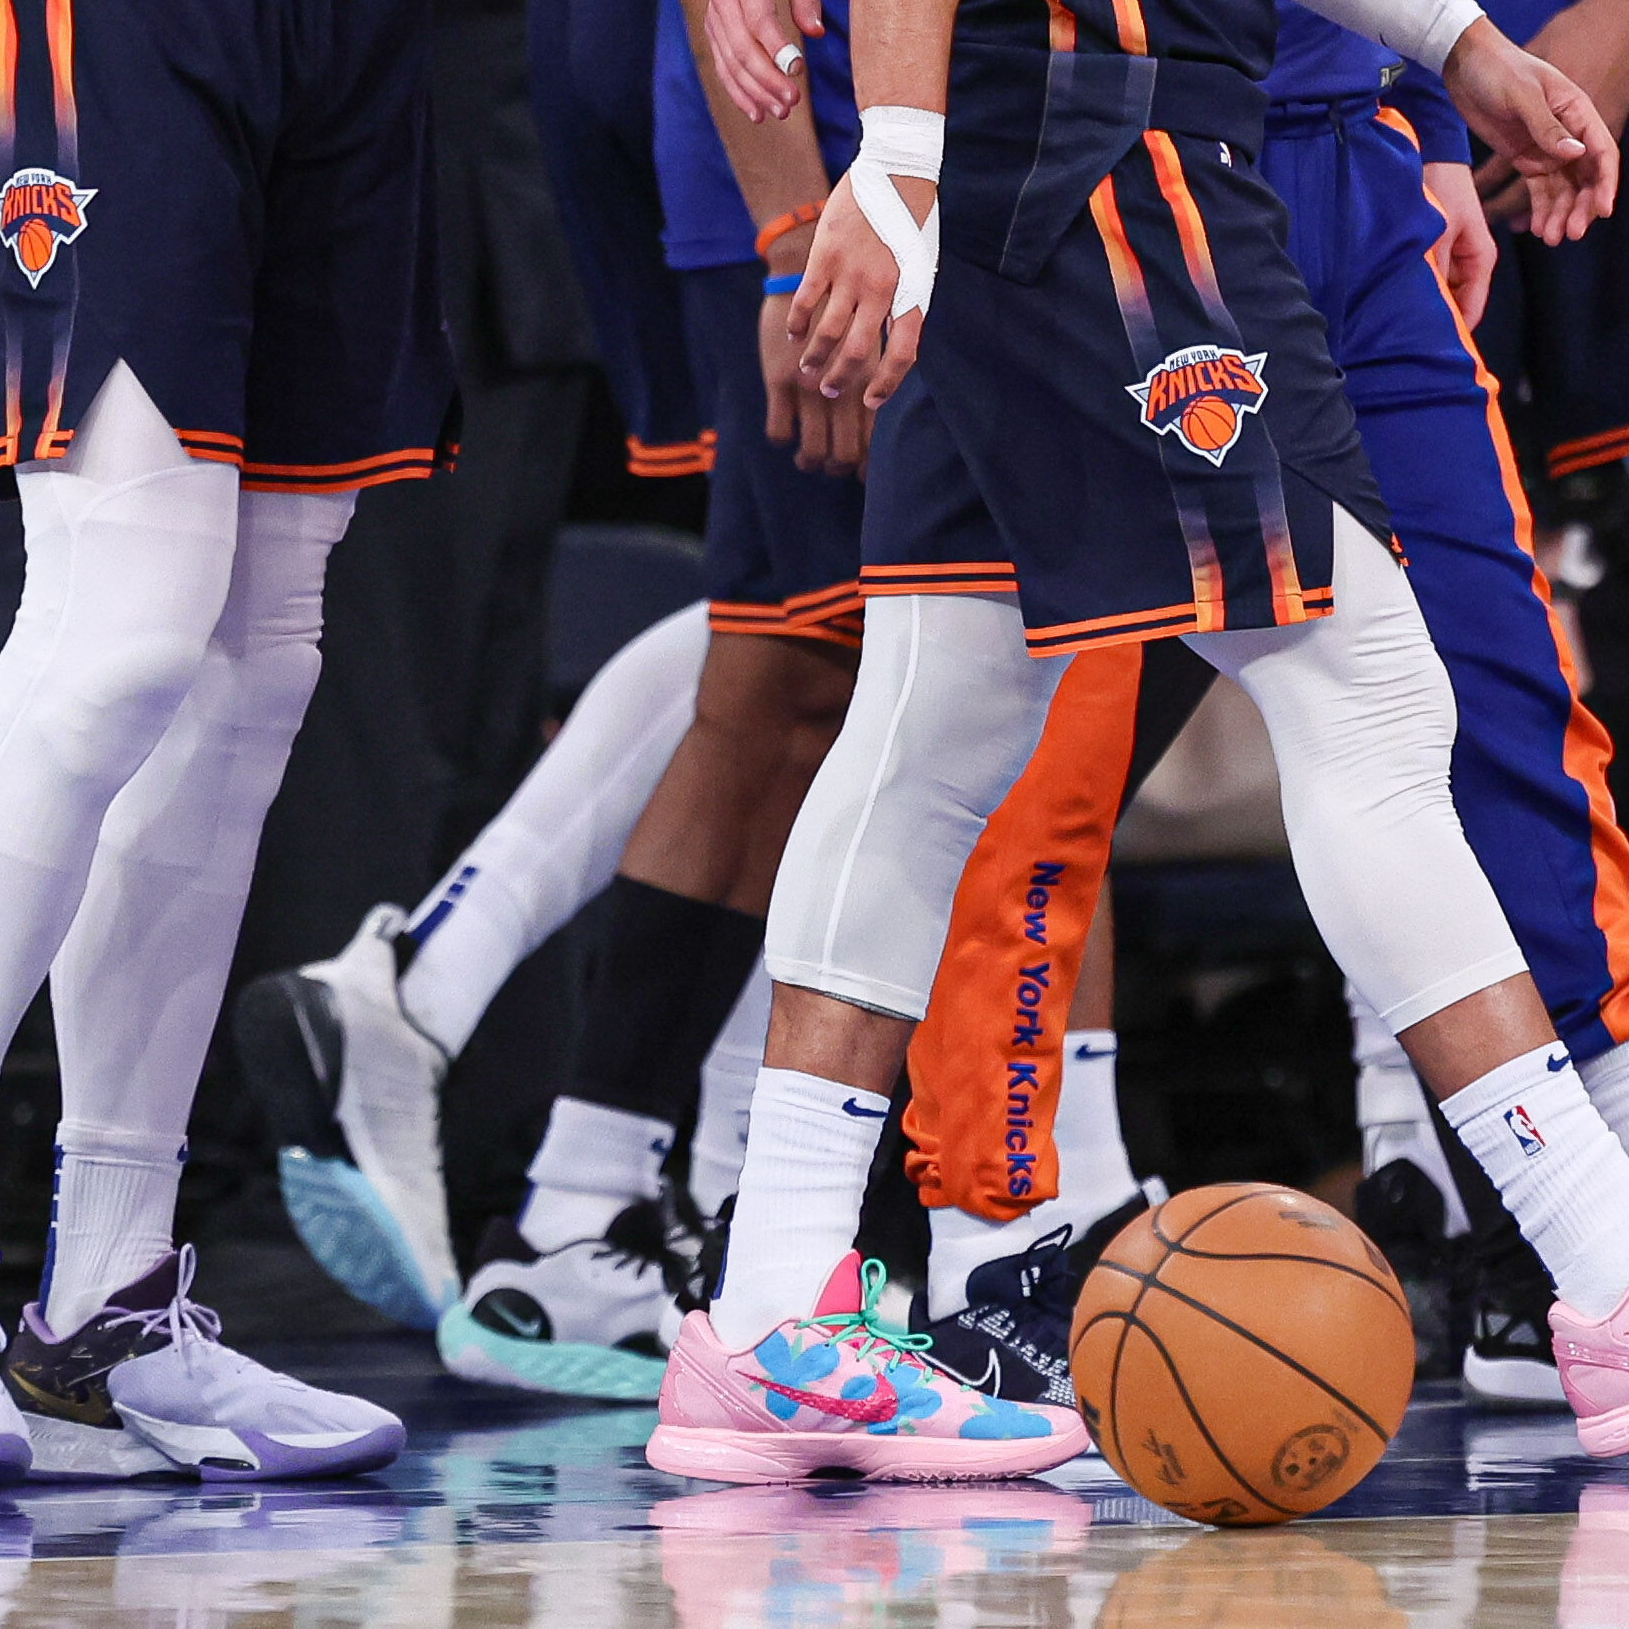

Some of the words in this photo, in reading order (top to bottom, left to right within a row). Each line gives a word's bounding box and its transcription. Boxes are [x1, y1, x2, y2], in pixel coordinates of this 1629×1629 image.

[1, 182, 82, 231] KNICKS
[1146, 354, 1264, 422] KNICKS
[1170, 353, 1190, 371] NEW
[1191, 349, 1219, 363] YORK
[1024, 861, 1066, 945] New
[1011, 962, 1051, 1048] York
[1004, 1061, 1039, 1199] Knicks
